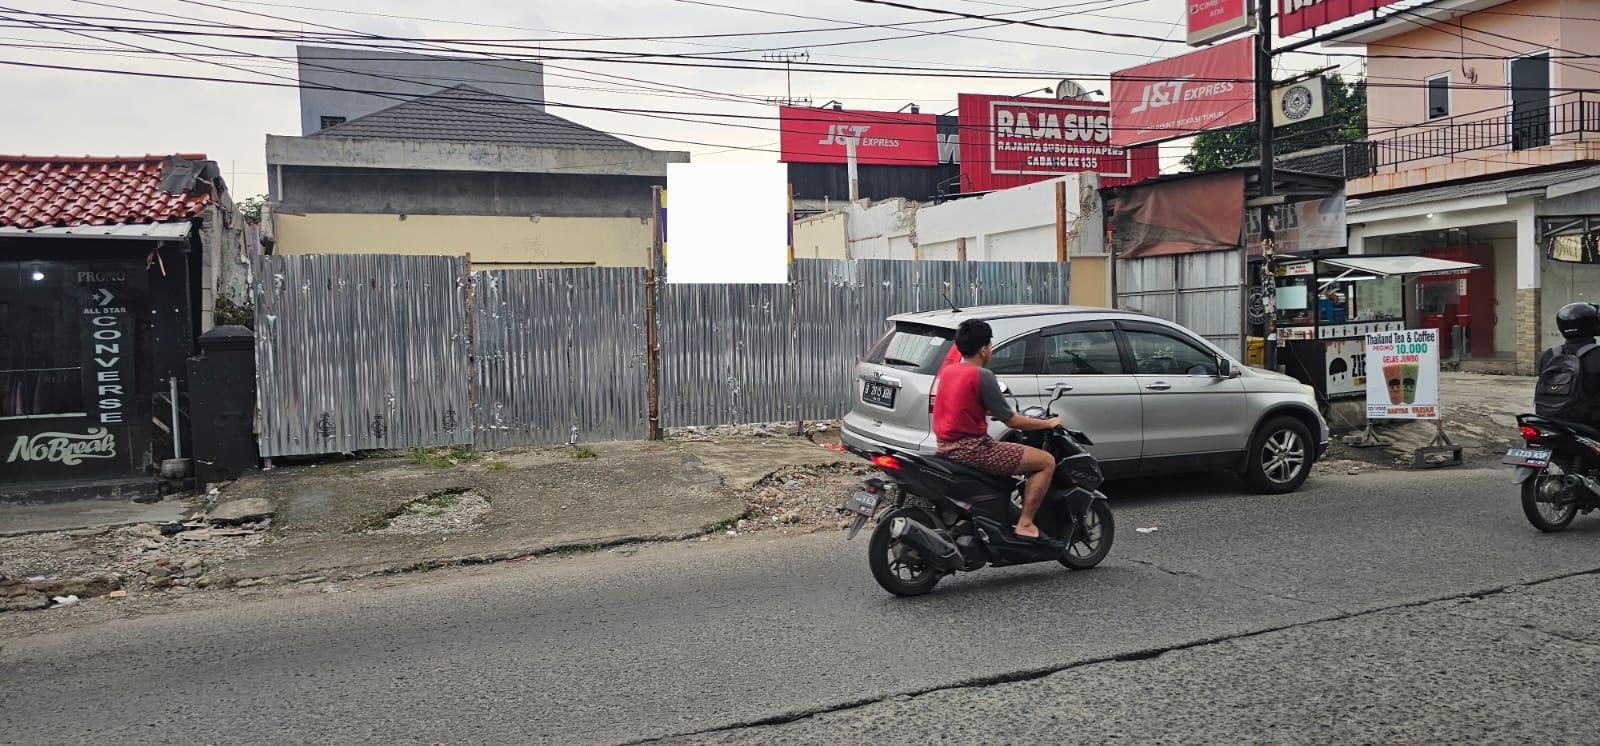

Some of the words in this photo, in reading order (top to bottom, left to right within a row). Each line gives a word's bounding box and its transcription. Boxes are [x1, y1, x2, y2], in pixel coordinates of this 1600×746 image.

[1131, 74, 1195, 114] J&T
[1183, 81, 1234, 101] EXPRESS
[997, 110, 1062, 140] RAJA
[1064, 114, 1112, 142] SUS
[818, 125, 871, 145] J&T
[862, 137, 900, 148] EXPRESS
[997, 141, 1042, 153] RAJANYA
[1042, 143, 1067, 154] SUSU
[1067, 145, 1086, 155] DAN
[1086, 146, 1124, 156] DIAPERS
[1067, 157, 1079, 167] KE
[1080, 157, 1098, 168] 135
[77, 271, 126, 282] PROMO
[1367, 333, 1393, 345] Thailand
[1394, 332, 1405, 344] Tea
[1406, 332, 1412, 343] &
[1413, 330, 1435, 343] Coffee
[1396, 343, 1428, 354] 10.000
[1383, 355, 1399, 363] GELAS
[92, 316, 124, 423] CONVERSE
